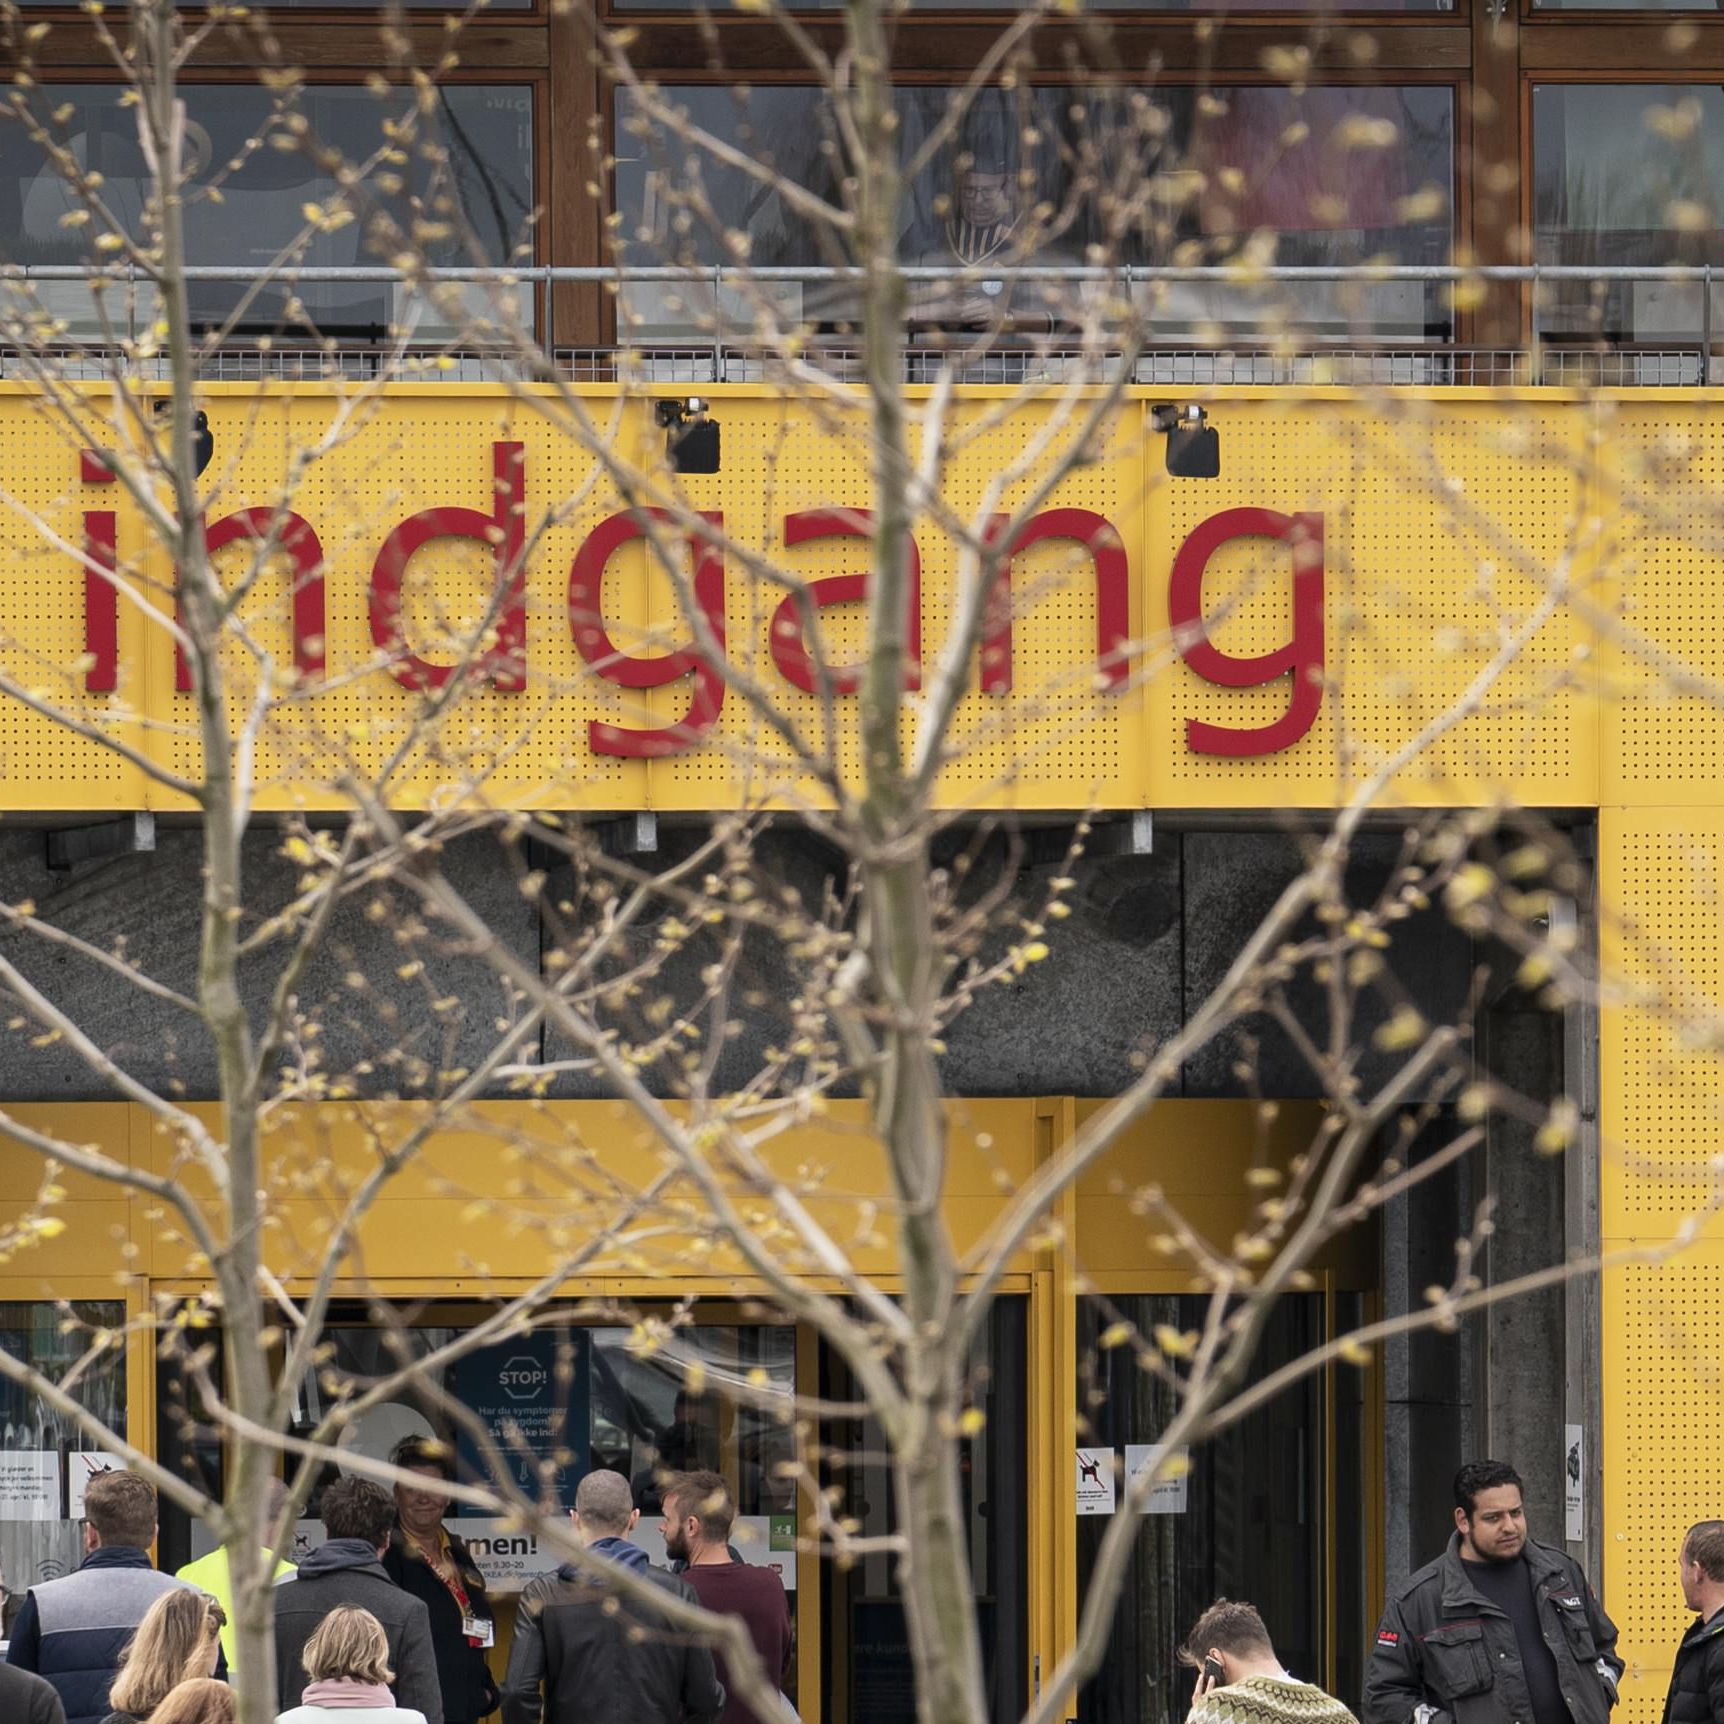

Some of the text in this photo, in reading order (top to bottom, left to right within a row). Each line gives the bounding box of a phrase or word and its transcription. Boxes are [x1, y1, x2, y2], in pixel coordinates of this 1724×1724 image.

[81, 441, 1325, 757] indgang
[499, 1371, 547, 1385] STOP!
[479, 1407, 568, 1419] Har du symptomer
